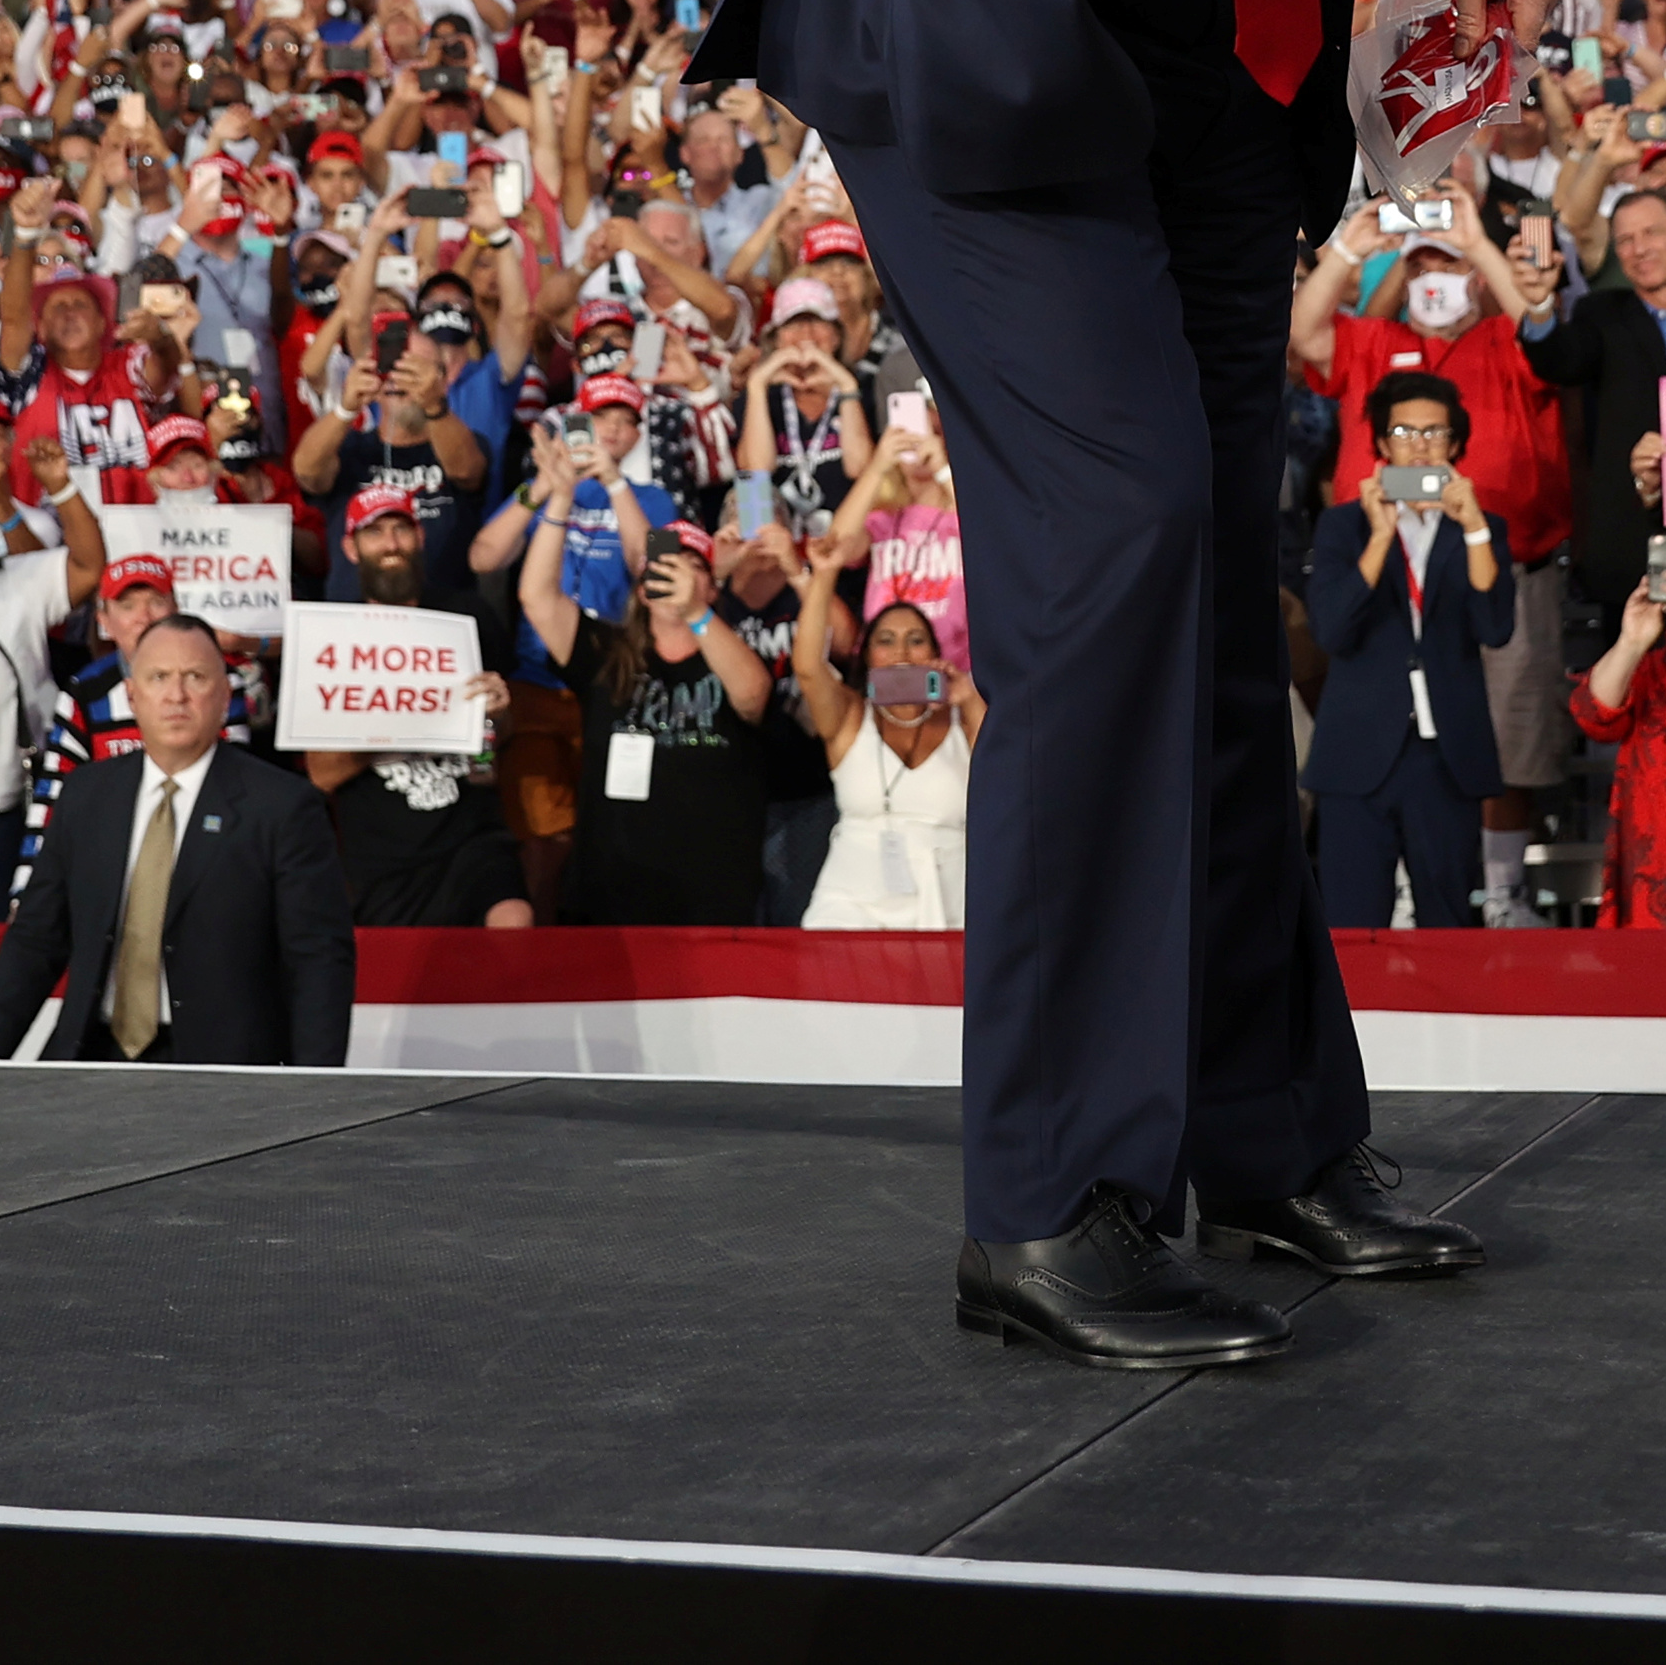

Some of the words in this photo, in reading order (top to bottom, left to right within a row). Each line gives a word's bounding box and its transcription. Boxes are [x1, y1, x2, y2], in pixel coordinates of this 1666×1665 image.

[581, 350, 629, 377] MAG
[162, 528, 230, 547] MAKE
[172, 556, 278, 582] ERICA
[870, 536, 963, 584] TRUM
[201, 590, 279, 610] AGAIN
[315, 645, 337, 670] 4
[352, 645, 457, 674] MORE
[317, 684, 453, 713] YEARS!
